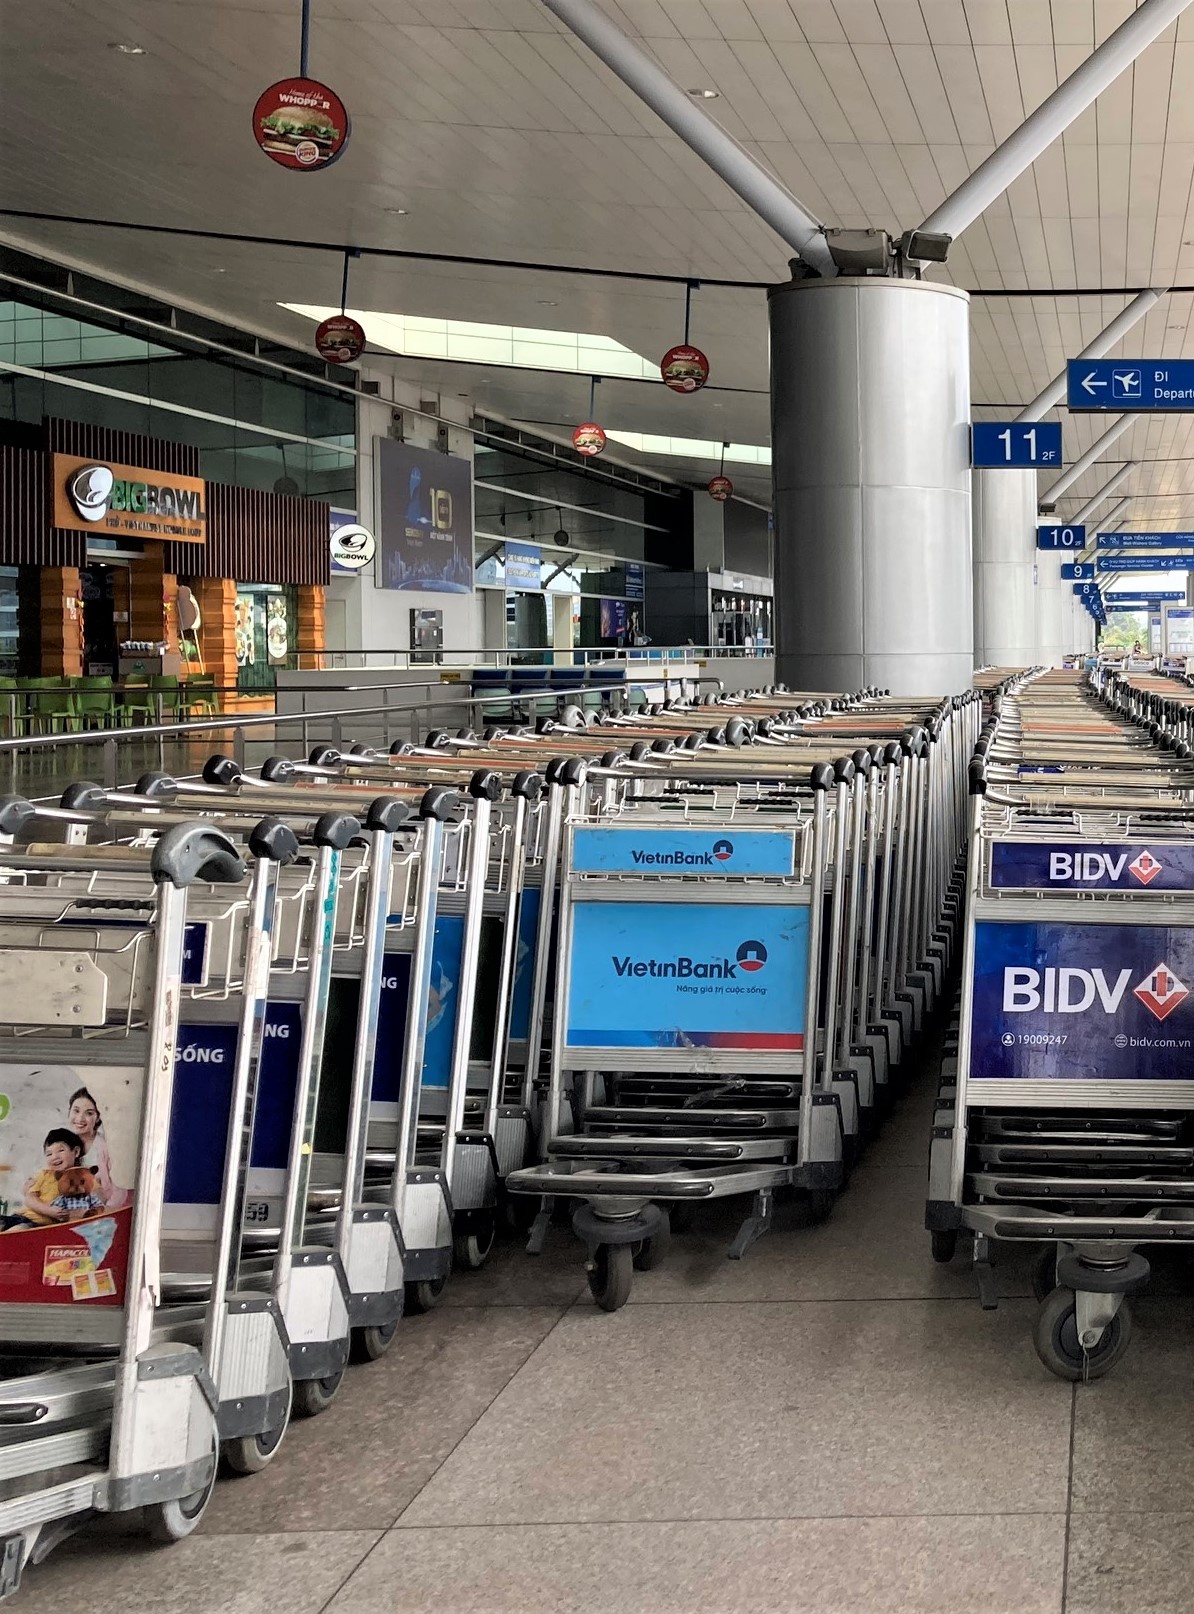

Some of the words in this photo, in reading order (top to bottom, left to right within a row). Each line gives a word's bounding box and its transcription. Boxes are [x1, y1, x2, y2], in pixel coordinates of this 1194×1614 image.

[1155, 371, 1168, 382] ĐI
[998, 428, 1037, 461] 11
[1042, 451, 1056, 461] 2F
[111, 480, 207, 521] BIGBOWL
[1050, 528, 1074, 547] 10
[334, 553, 369, 561] BIGBOWL
[1074, 565, 1083, 577] 9
[1083, 585, 1090, 594] 8
[1088, 596, 1095, 604] 7
[631, 850, 713, 865] VietinBank
[1049, 852, 1128, 881] BIDV
[612, 956, 737, 979] VietinBank
[676, 985, 699, 994] Nâng
[700, 985, 713, 994] giá
[746, 985, 767, 996] sống
[1002, 966, 1133, 1014] BIDV
[1018, 1034, 1069, 1045] 19009247
[1129, 1036, 1192, 1048] bidv.com.vn
[174, 1043, 225, 1063] SỐNG
